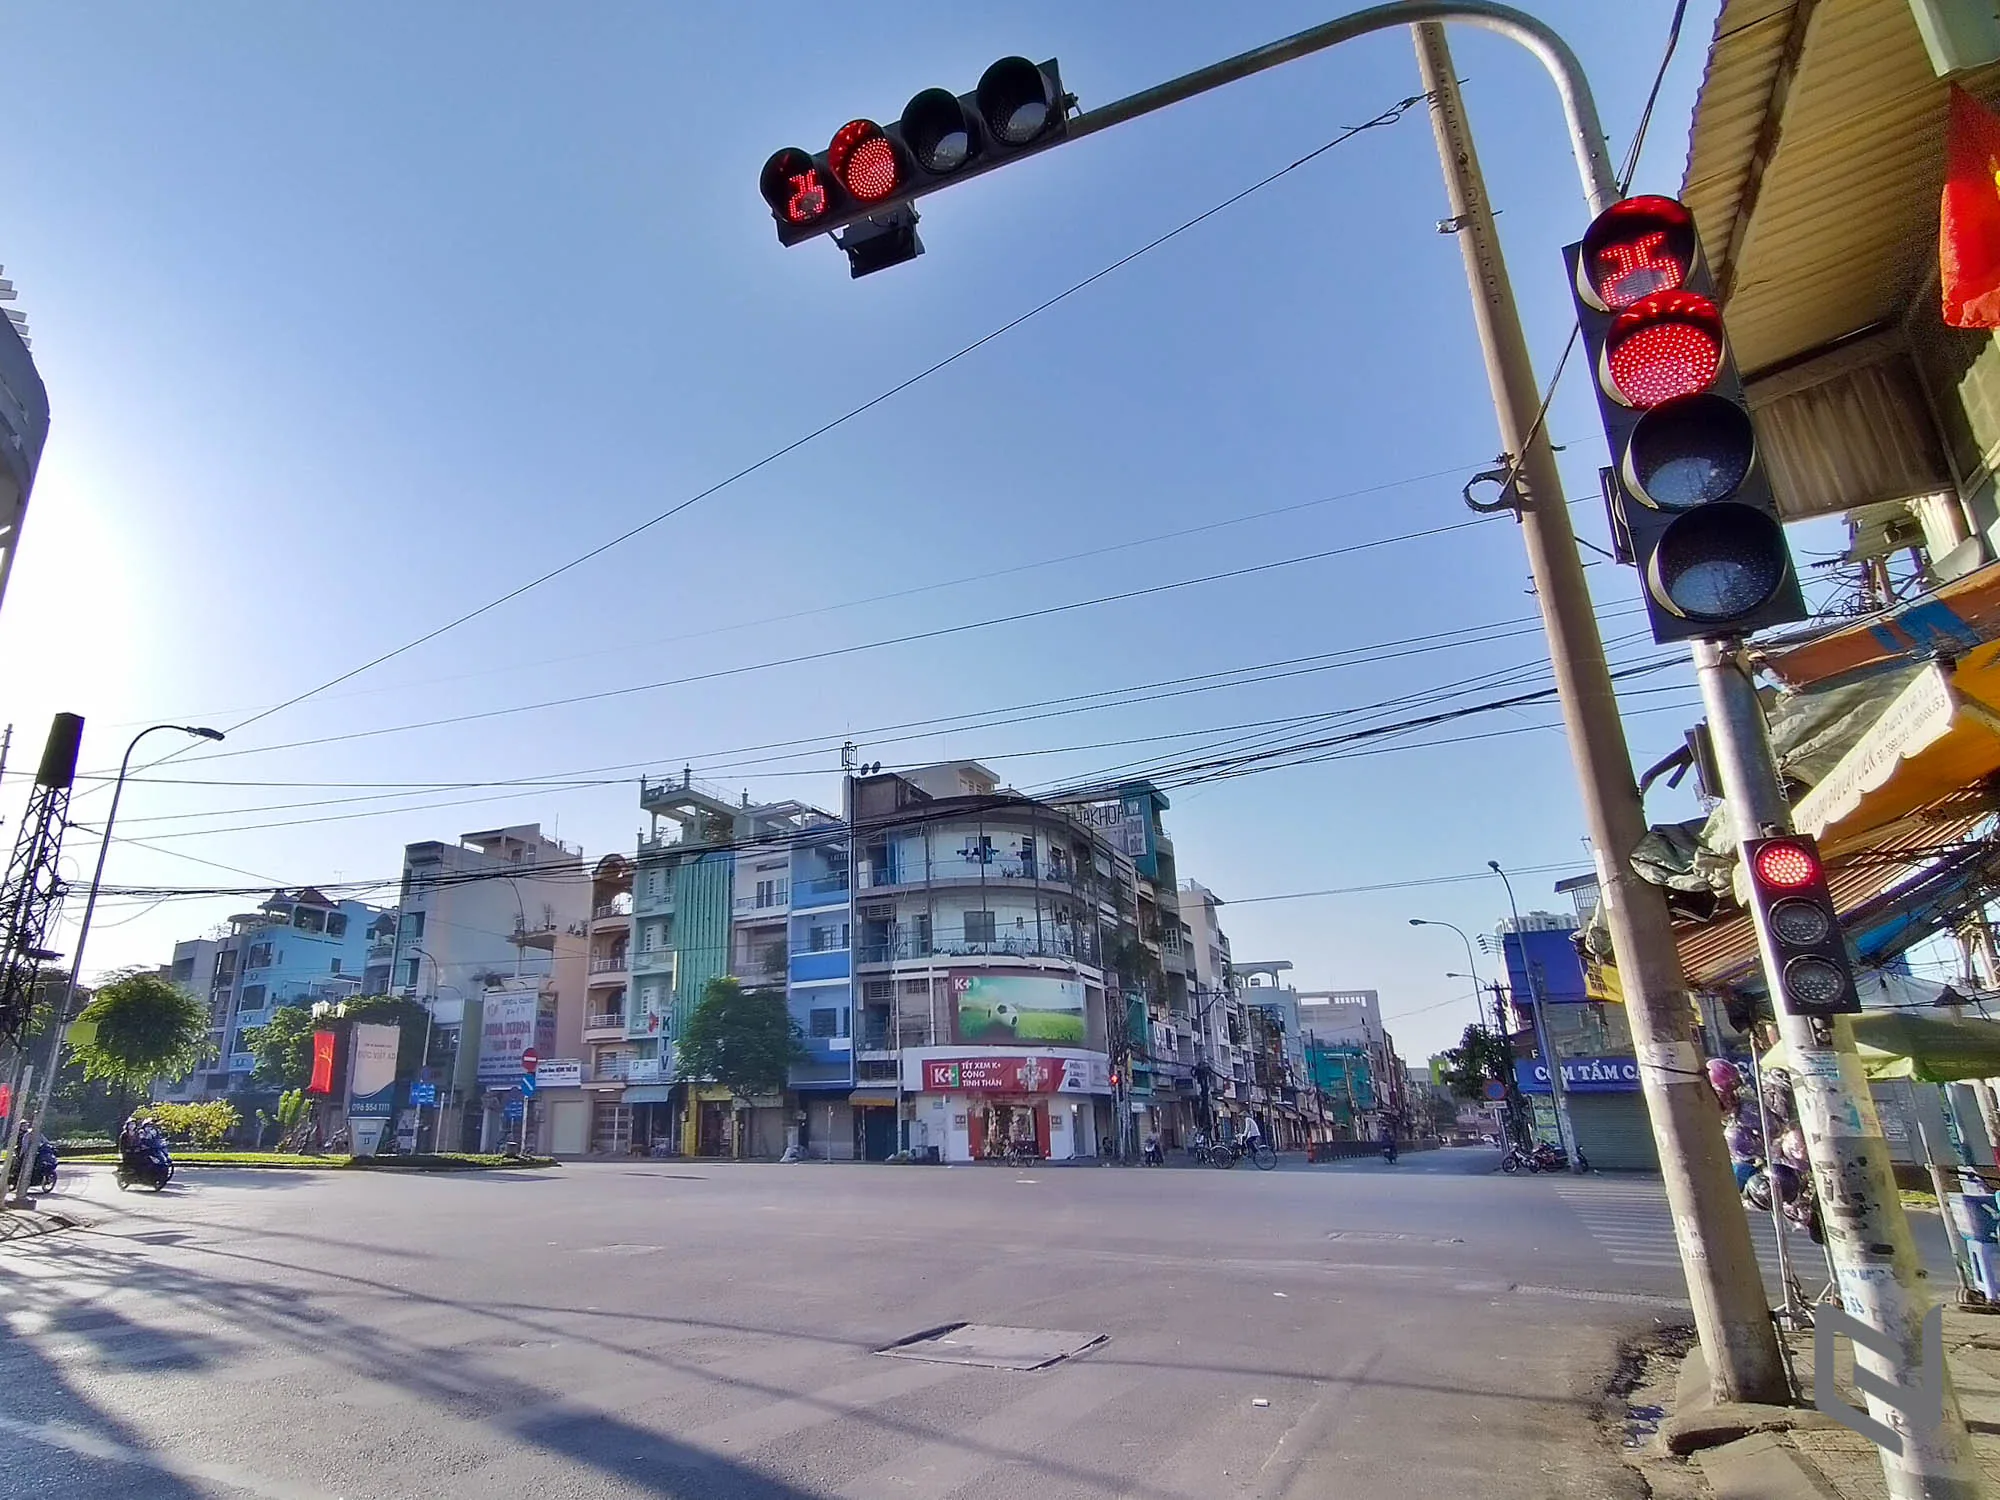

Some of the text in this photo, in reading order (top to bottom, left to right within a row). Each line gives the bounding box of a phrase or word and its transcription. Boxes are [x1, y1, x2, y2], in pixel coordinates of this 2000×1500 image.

[954, 978, 972, 990] K+
[661, 1015, 671, 1070] KTV
[934, 1067, 956, 1083] K+
